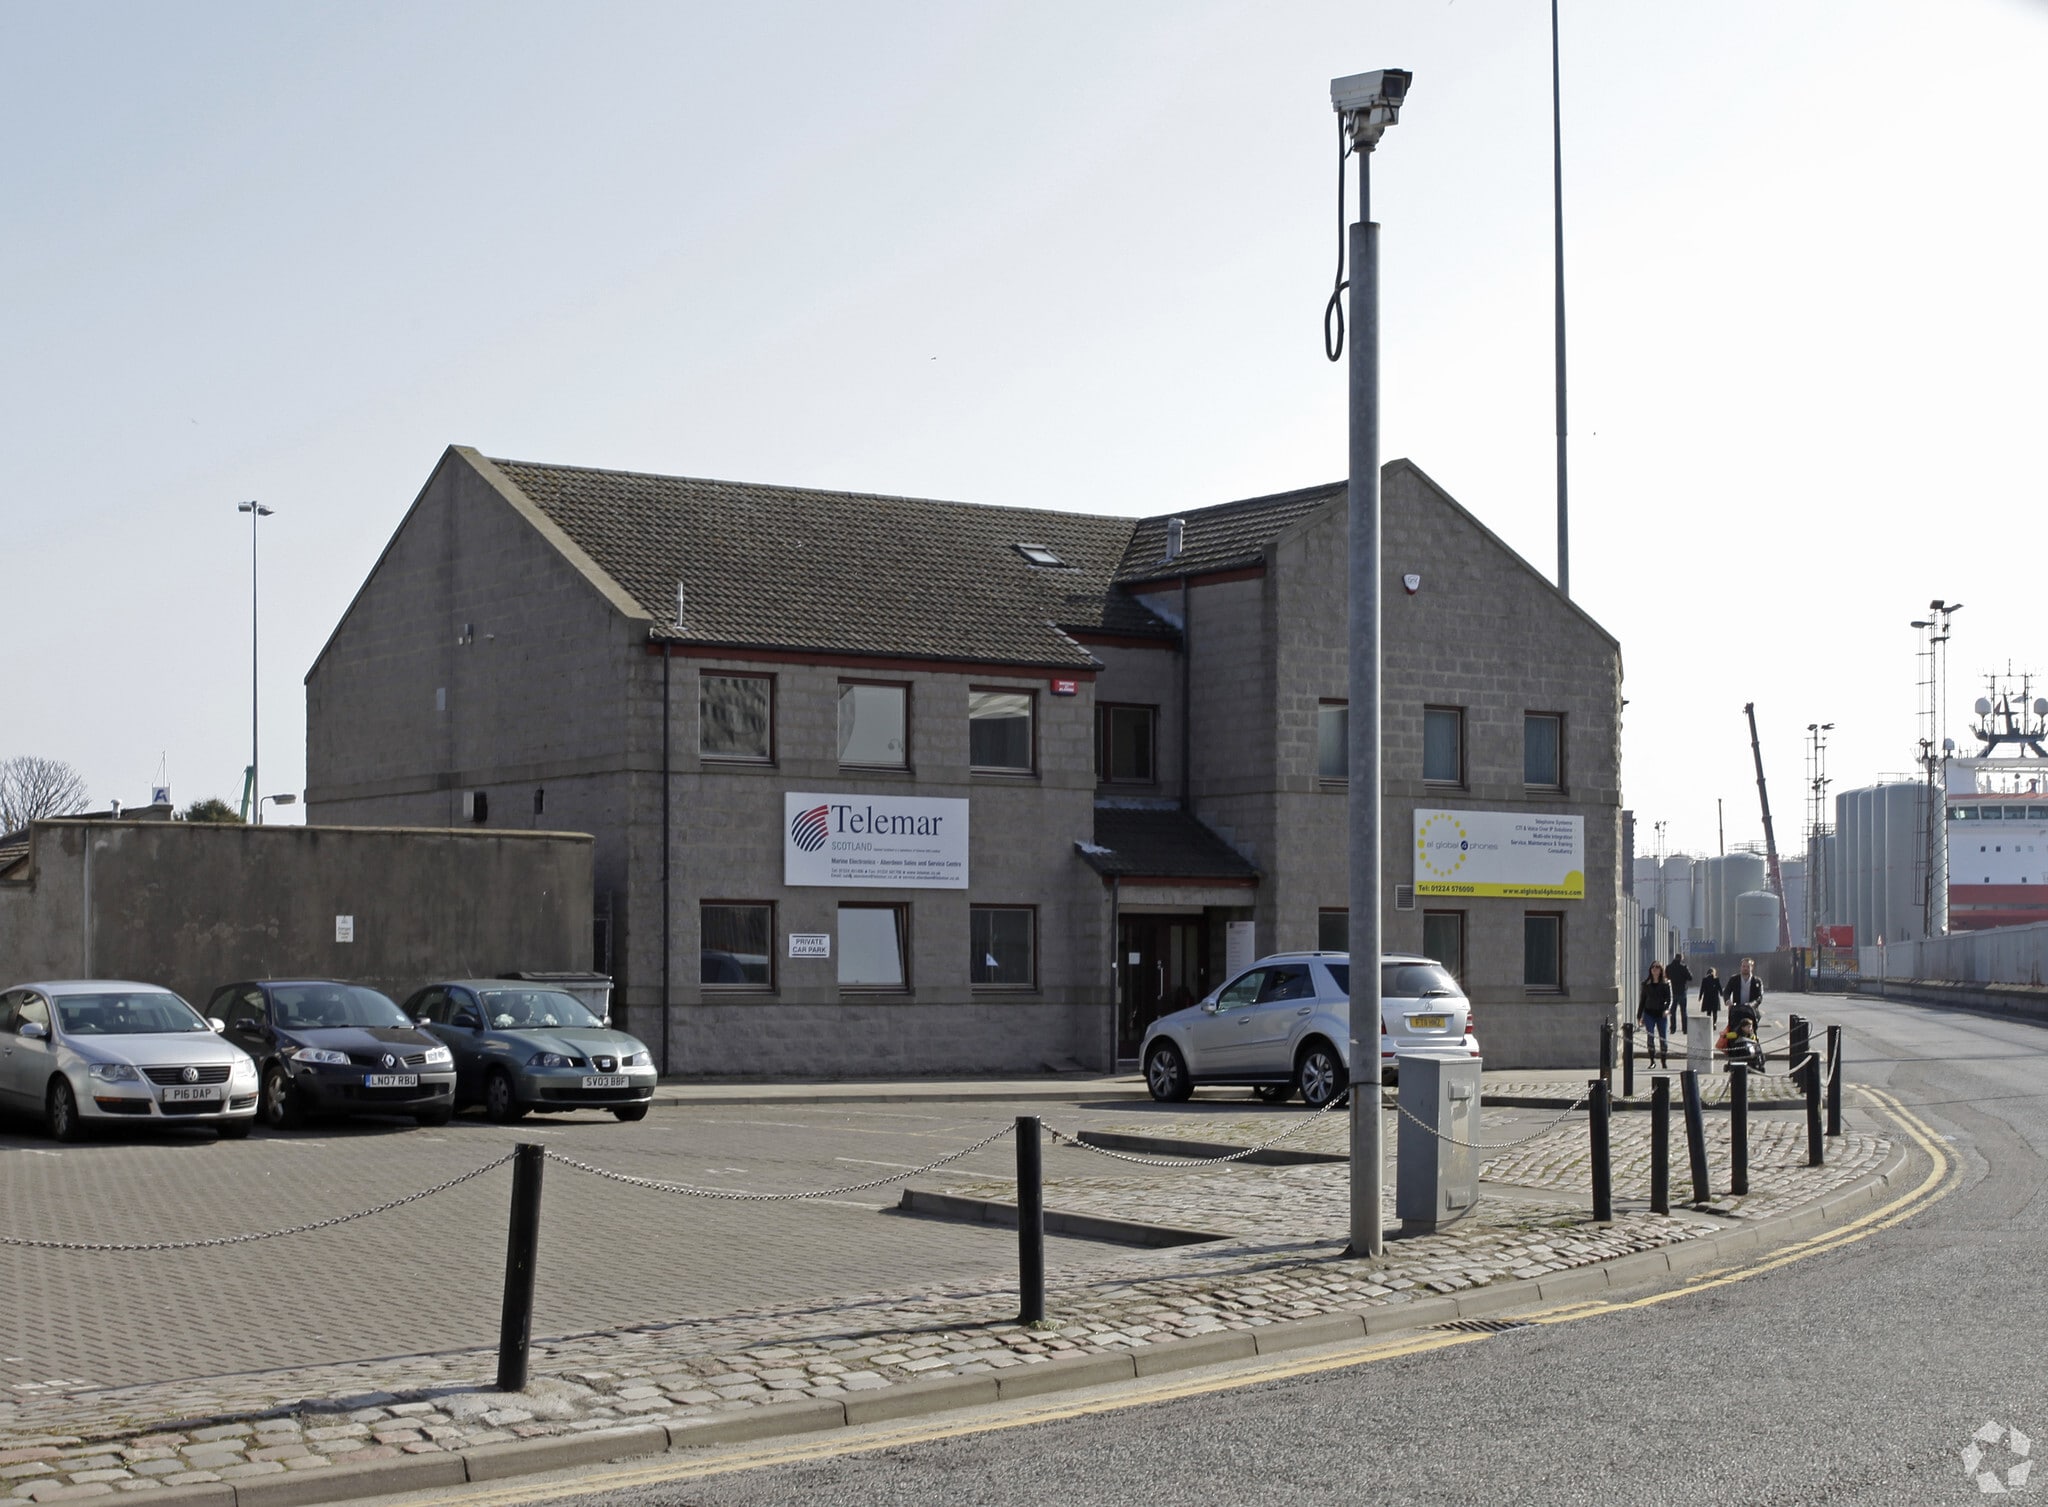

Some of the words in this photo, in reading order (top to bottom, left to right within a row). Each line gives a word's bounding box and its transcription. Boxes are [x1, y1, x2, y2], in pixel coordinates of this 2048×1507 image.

[831, 805, 943, 836] Telemar
[831, 841, 873, 852] SCOTLAND
[1436, 841, 1459, 850] global
[1469, 842, 1499, 850] phones
[371, 1075, 396, 1086] LN07
[398, 1075, 416, 1086] RBU
[586, 1076, 609, 1087] SV03
[174, 1088, 191, 1100] P16
[192, 1088, 212, 1100] DAP
